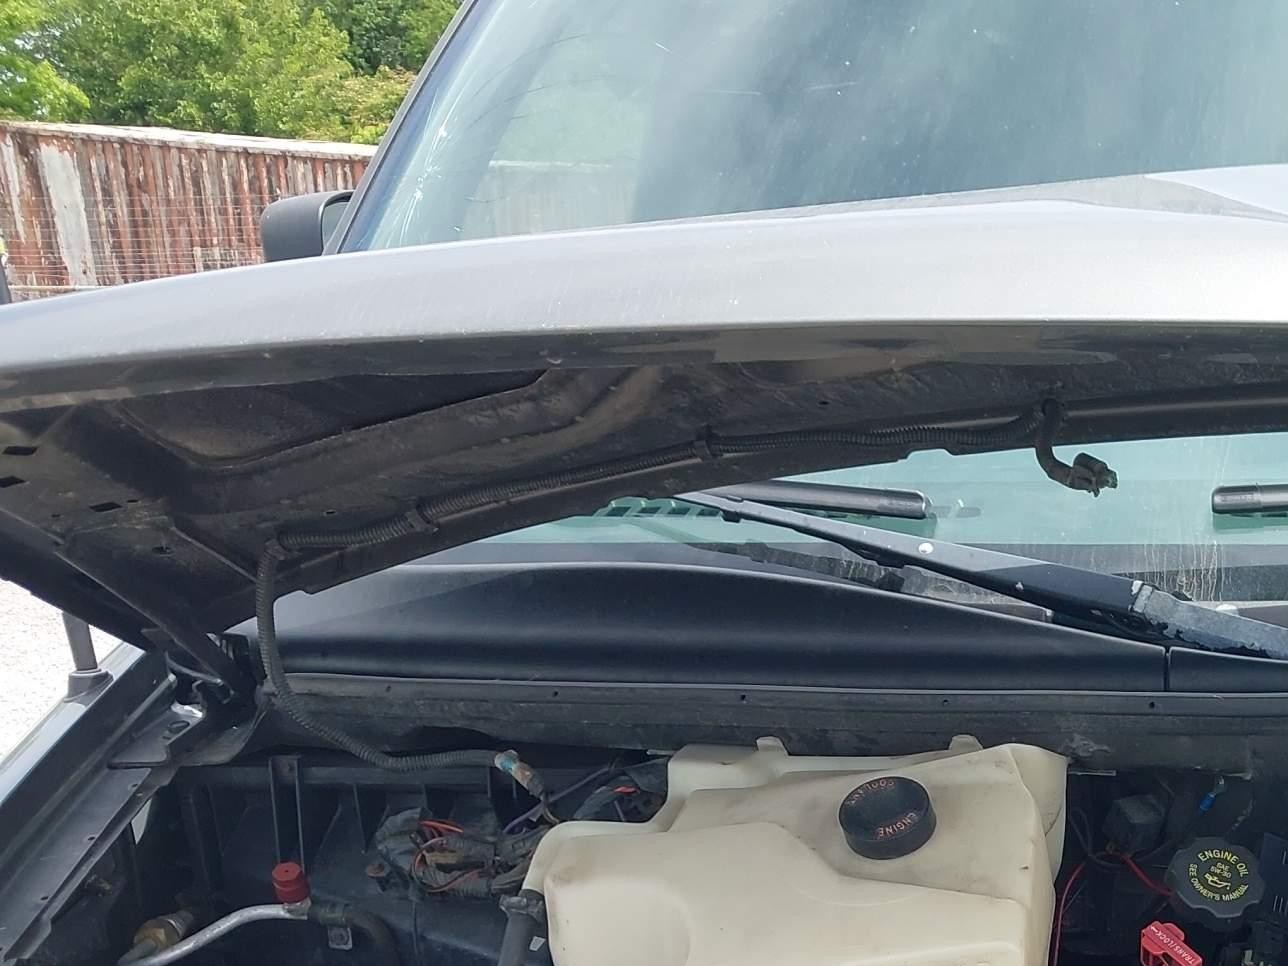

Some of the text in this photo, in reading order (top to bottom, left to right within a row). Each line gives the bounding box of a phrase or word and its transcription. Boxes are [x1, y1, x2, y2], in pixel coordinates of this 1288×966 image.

[876, 811, 917, 839] ENGINE
[1197, 849, 1249, 878] ENGINE OIL
[1188, 863, 1249, 901] SEE OWNER'S MANUAL
[1155, 930, 1196, 965] TRANS/LOCK
